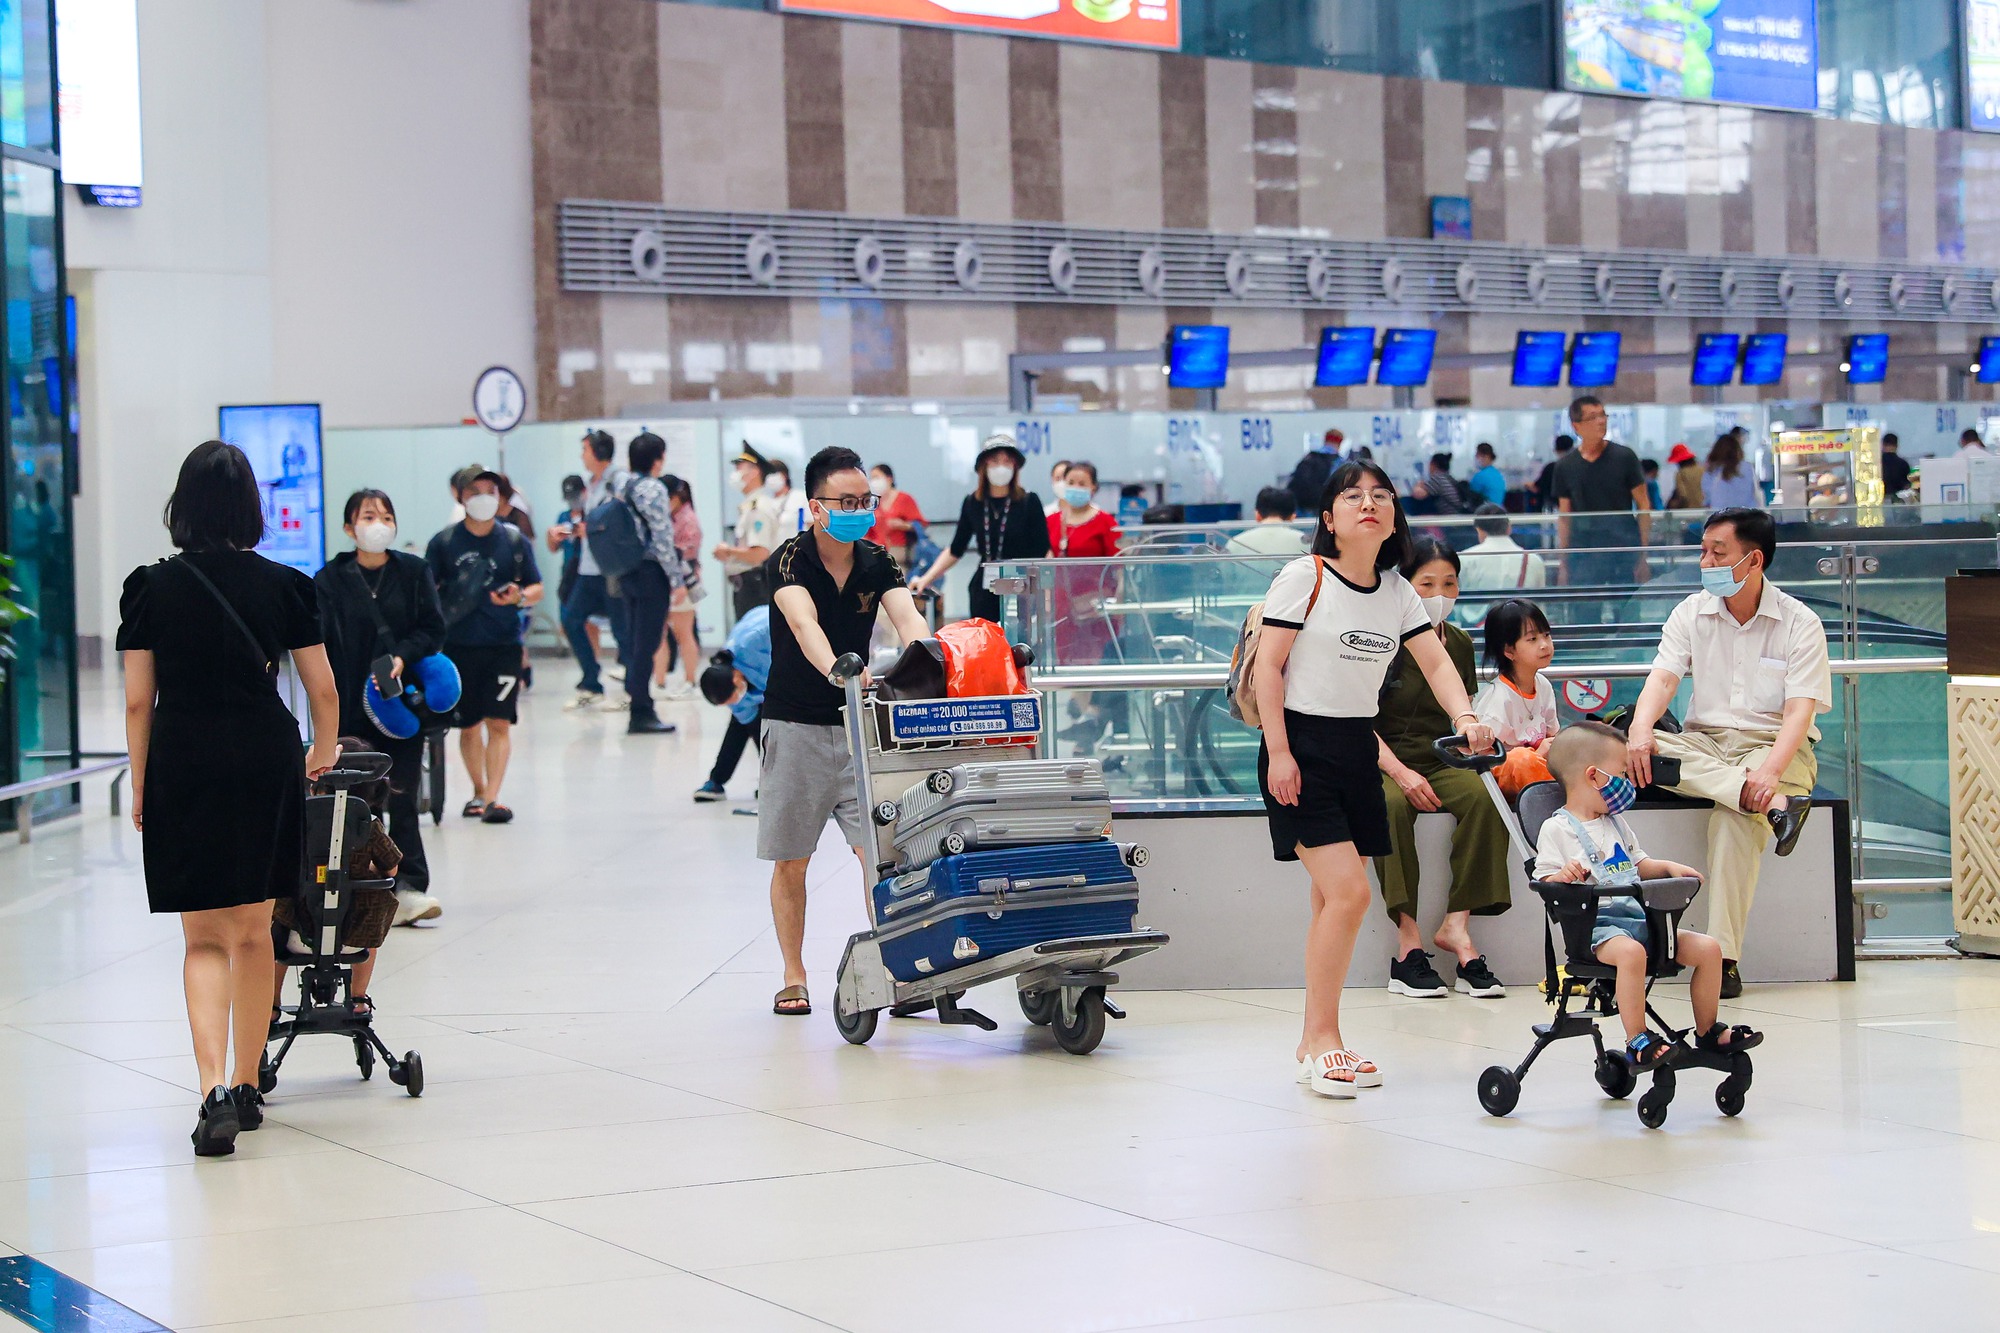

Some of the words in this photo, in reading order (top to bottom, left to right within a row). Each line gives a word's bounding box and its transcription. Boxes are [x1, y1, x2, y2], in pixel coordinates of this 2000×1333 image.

[1016, 421, 1051, 455] B01
[1241, 418, 1272, 450] B03
[1373, 416, 1402, 446] B04
[496, 675, 516, 701] 7
[898, 706, 928, 717] BIZMAN
[940, 705, 967, 718] 20.000
